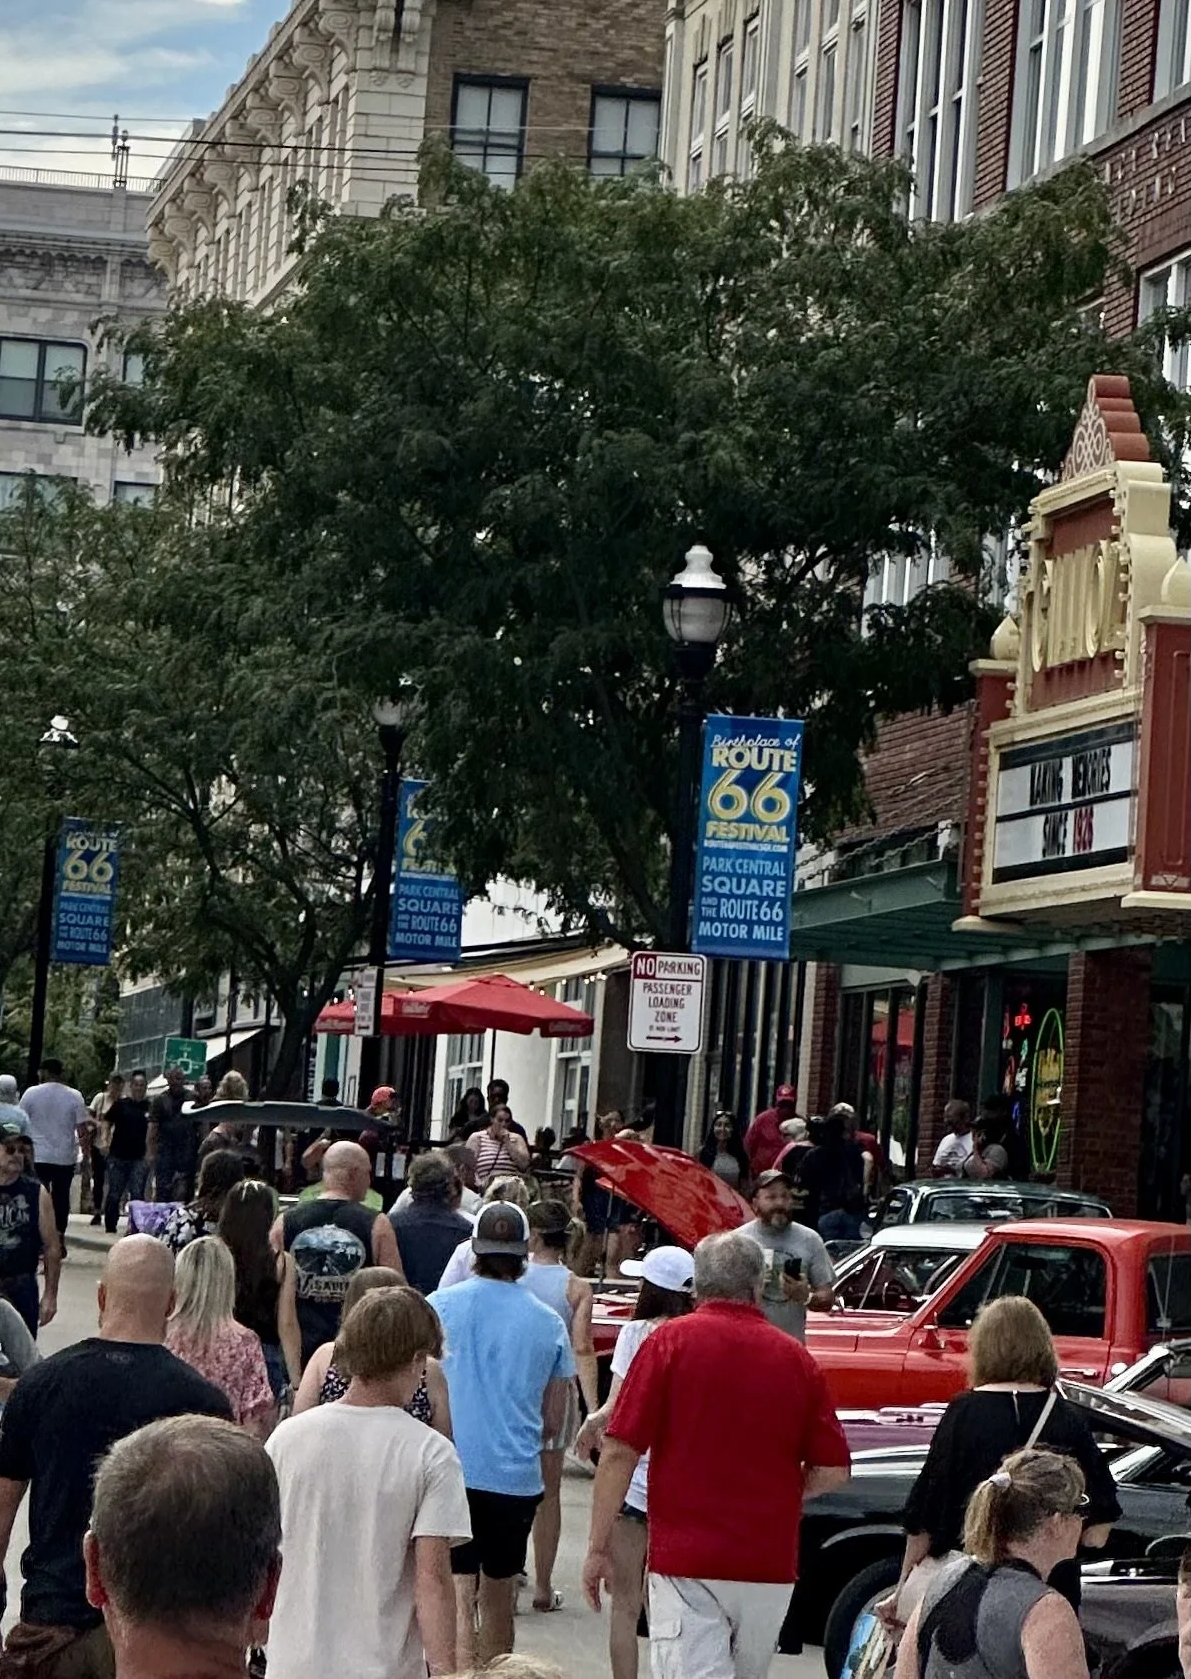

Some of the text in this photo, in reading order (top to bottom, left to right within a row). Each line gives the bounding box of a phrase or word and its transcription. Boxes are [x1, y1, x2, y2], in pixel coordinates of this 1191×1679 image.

[711, 745, 798, 772] ROUTE
[707, 767, 791, 823] 66
[705, 820, 791, 843] FESTIVAL
[63, 849, 114, 882] 66
[702, 855, 786, 877] PARK CENTRAL
[701, 874, 787, 898] SQUARE
[397, 897, 460, 915] SQUARE
[719, 897, 759, 921] ROUTE
[58, 912, 111, 927] SQUARE
[395, 932, 432, 946] MOTOR
[698, 921, 785, 941] MOTOR MILE
[636, 957, 700, 976] NO PARKING
[642, 982, 692, 995] PASSENGER
[648, 996, 685, 1009] LOADING
[654, 1011, 678, 1023] ZONE
